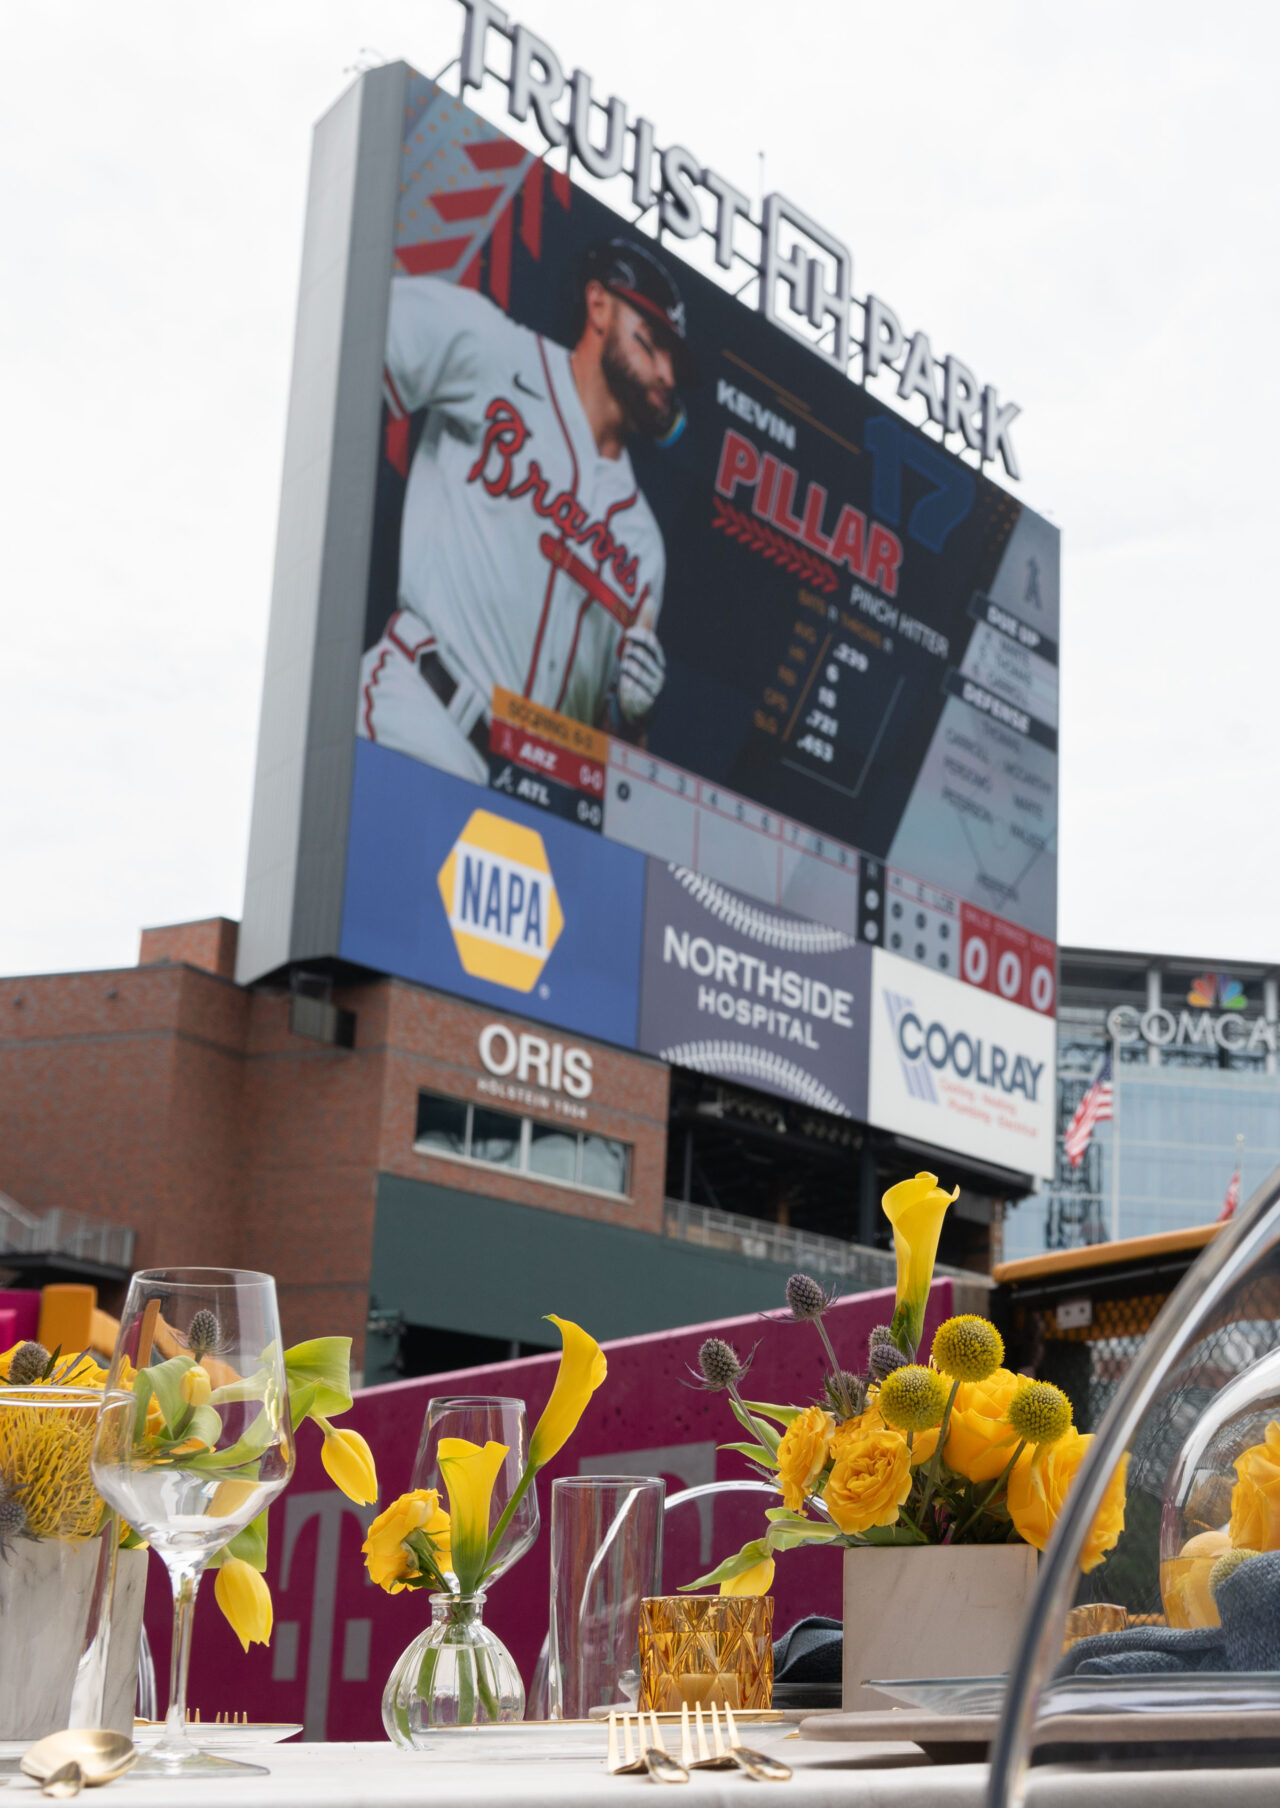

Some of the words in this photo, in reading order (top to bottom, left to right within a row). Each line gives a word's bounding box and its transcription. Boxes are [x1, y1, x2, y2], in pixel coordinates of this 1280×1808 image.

[457, 0, 751, 268] TRUIST
[862, 295, 1021, 480] PARK
[716, 379, 796, 450] KEVIN
[468, 397, 643, 598] Braves
[715, 428, 904, 597] PILLAR
[864, 415, 975, 555] 17
[850, 584, 897, 627] PINCH
[898, 612, 949, 659] HITTER
[987, 606, 1018, 637] DUE
[1018, 625, 1040, 647] UP
[963, 683, 1031, 734] DEFENSE
[797, 734, 834, 762] .453
[517, 777, 550, 806] ATL
[616, 780, 631, 801] 0
[709, 791, 717, 806] 4
[461, 854, 542, 949] NAPA
[662, 925, 855, 1028] NORTHSIDE
[964, 936, 988, 985] 0
[998, 950, 1022, 999] 0
[1030, 965, 1054, 1012] 0
[698, 985, 820, 1050] HOSPITAL
[478, 1024, 593, 1098] ORIS
[898, 1011, 1044, 1103] COOLRAY
